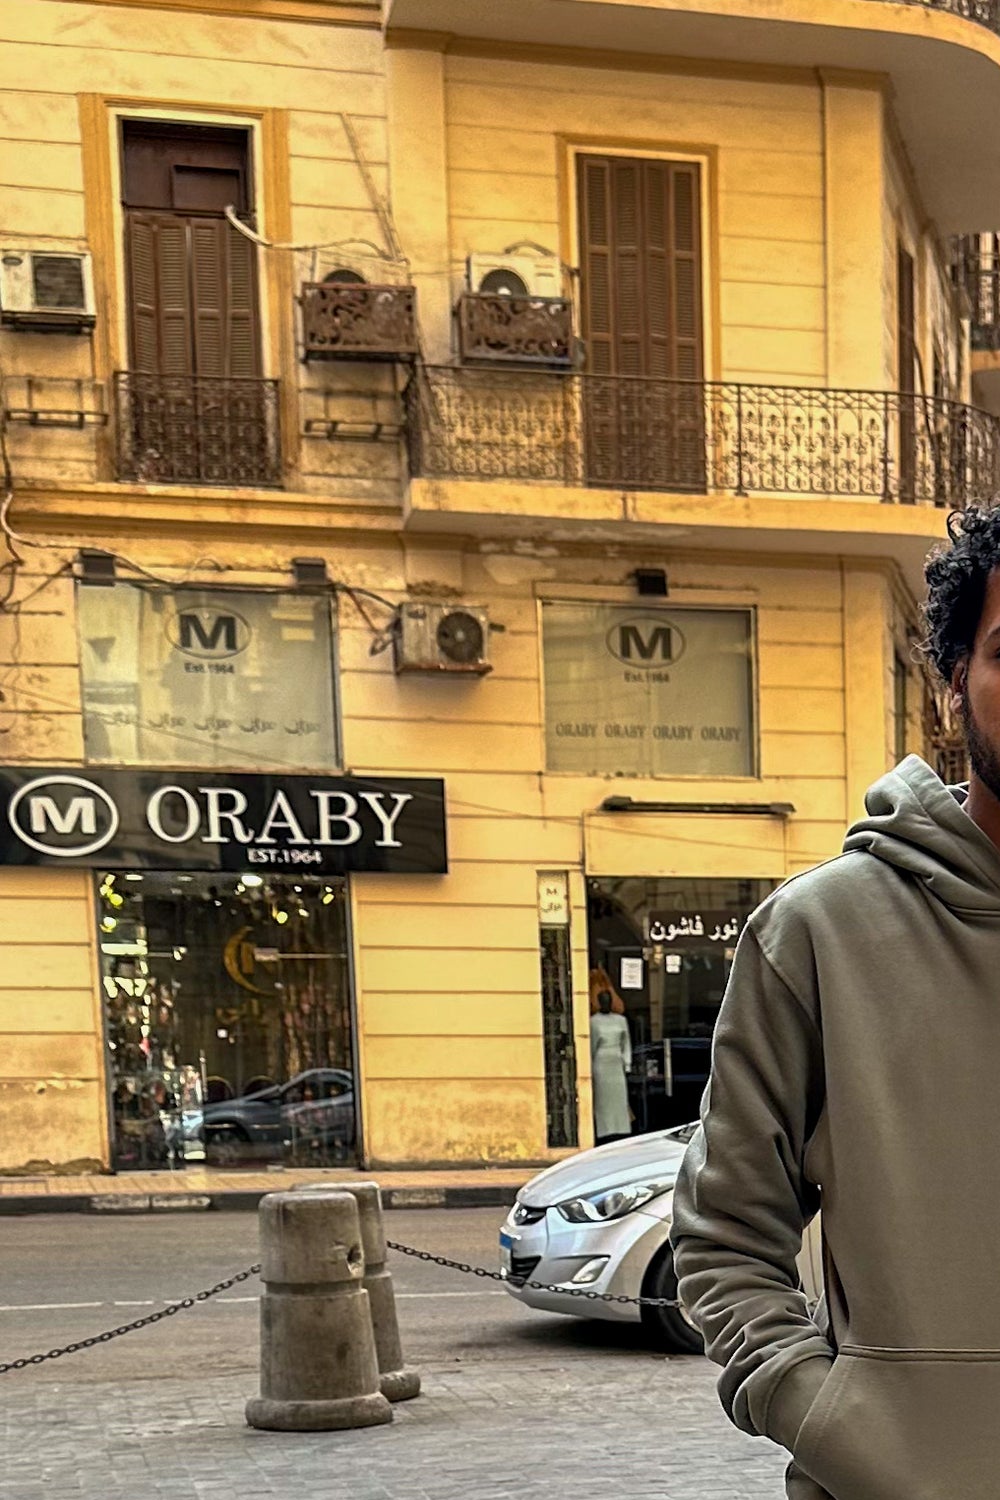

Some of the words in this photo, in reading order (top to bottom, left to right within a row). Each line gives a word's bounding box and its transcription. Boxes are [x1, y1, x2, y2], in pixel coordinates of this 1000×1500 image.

[179, 614, 237, 650] M
[620, 625, 672, 660] M
[555, 722, 598, 738] ORABY
[604, 723, 645, 739] ORABY
[653, 725, 694, 740] ORABY
[701, 726, 742, 742] ORABY
[30, 796, 97, 834] M
[146, 785, 413, 847] ORABY
[248, 848, 323, 865] EST.1964
[650, 915, 704, 941] فاشون
[708, 917, 738, 941] نور
